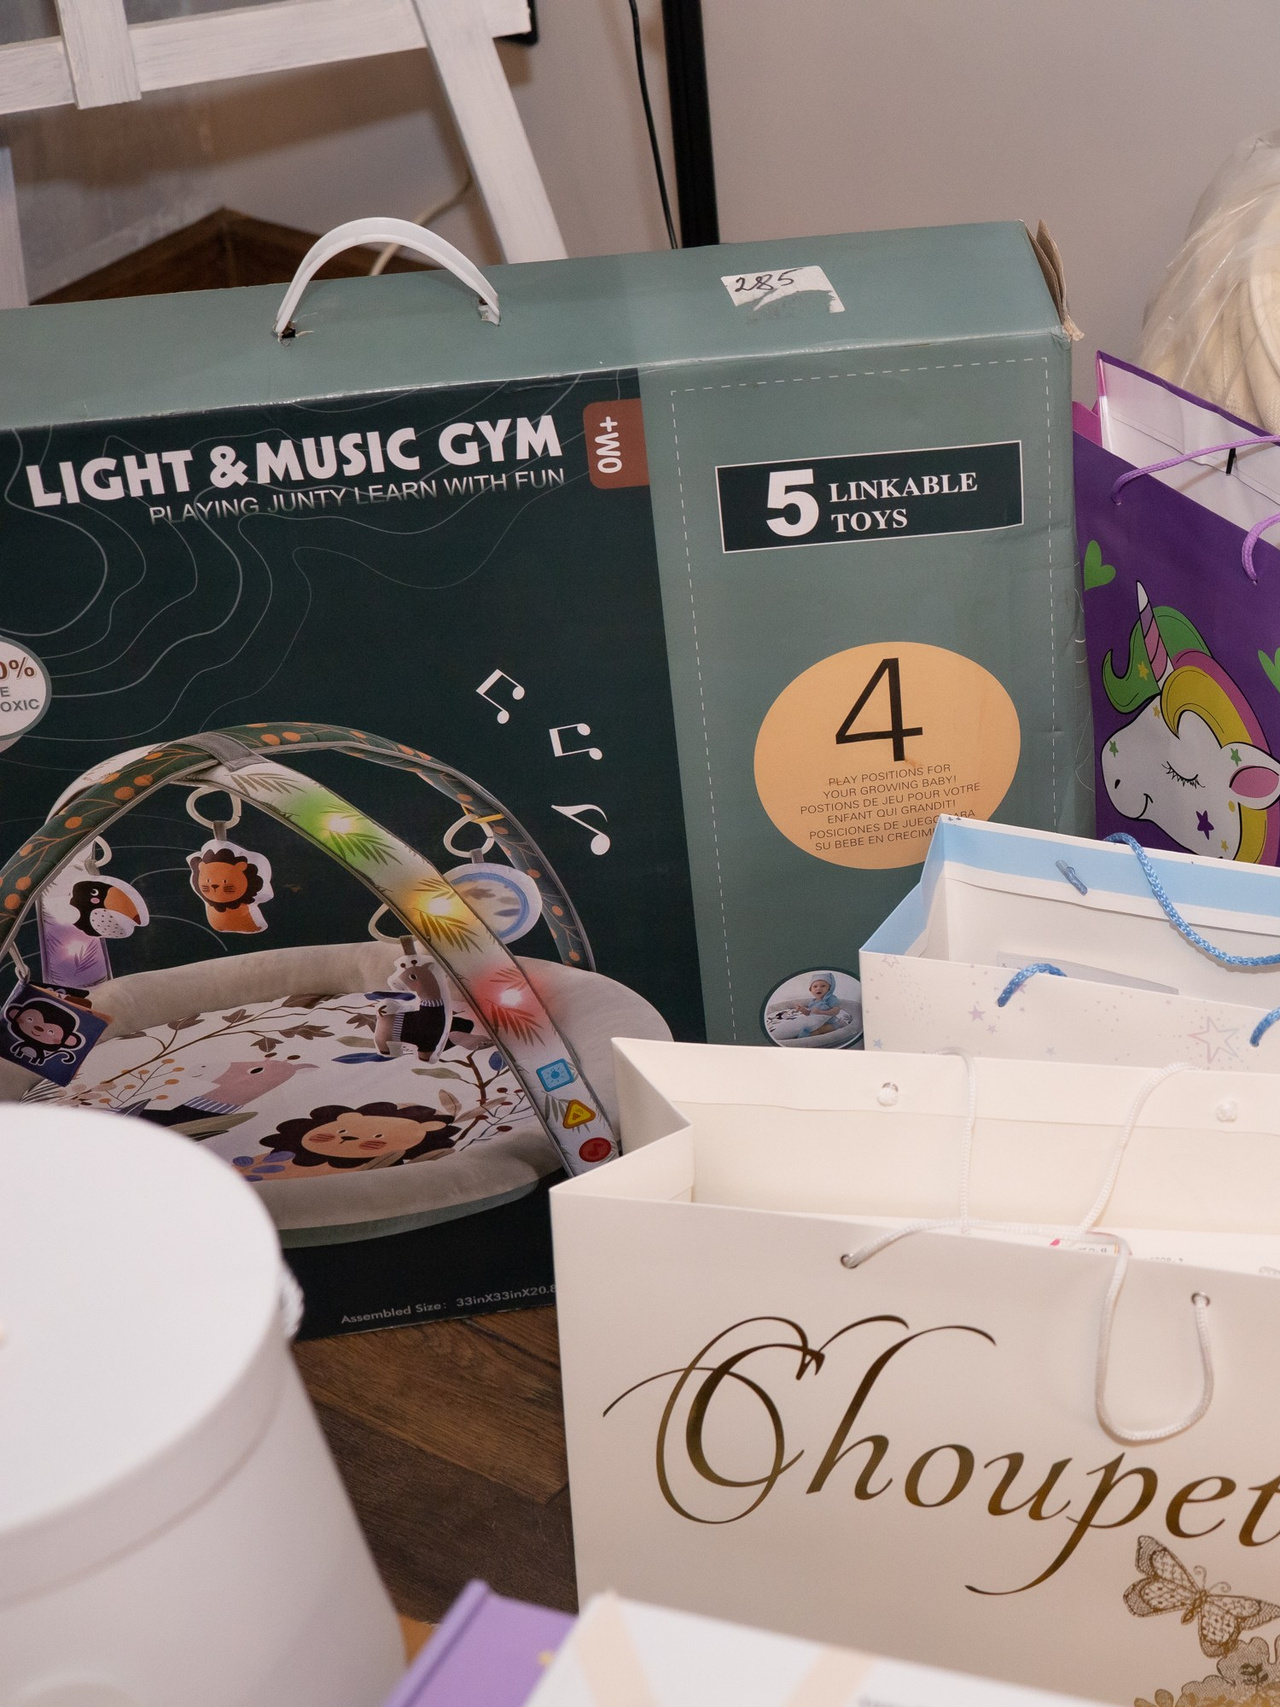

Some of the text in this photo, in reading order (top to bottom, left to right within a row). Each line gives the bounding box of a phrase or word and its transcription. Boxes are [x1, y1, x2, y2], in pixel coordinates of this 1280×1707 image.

[734, 268, 803, 292] 285
[26, 449, 194, 507] LIGHT
[438, 415, 563, 465] GYM
[149, 468, 565, 526] PLAYING JUNTY LEARN WITH FUN
[766, 468, 978, 537] 5 LINKABLE
[831, 508, 908, 533] TOYS
[835, 657, 923, 762] 4
[823, 775, 957, 800] YOUR GROWING BABY!
[828, 763, 951, 787] PLAY POSITIONS FOR
[800, 782, 981, 815] POSTIONS DE JEU POUR VOTRE
[827, 799, 956, 824] ENFANT QUI GRANDIT!
[809, 824, 881, 840] POSICIONES
[884, 820, 899, 831] DE
[815, 841, 832, 851] SU
[835, 837, 865, 849] BEBE
[868, 834, 884, 844] EN
[341, 1306, 411, 1324] Assembled
